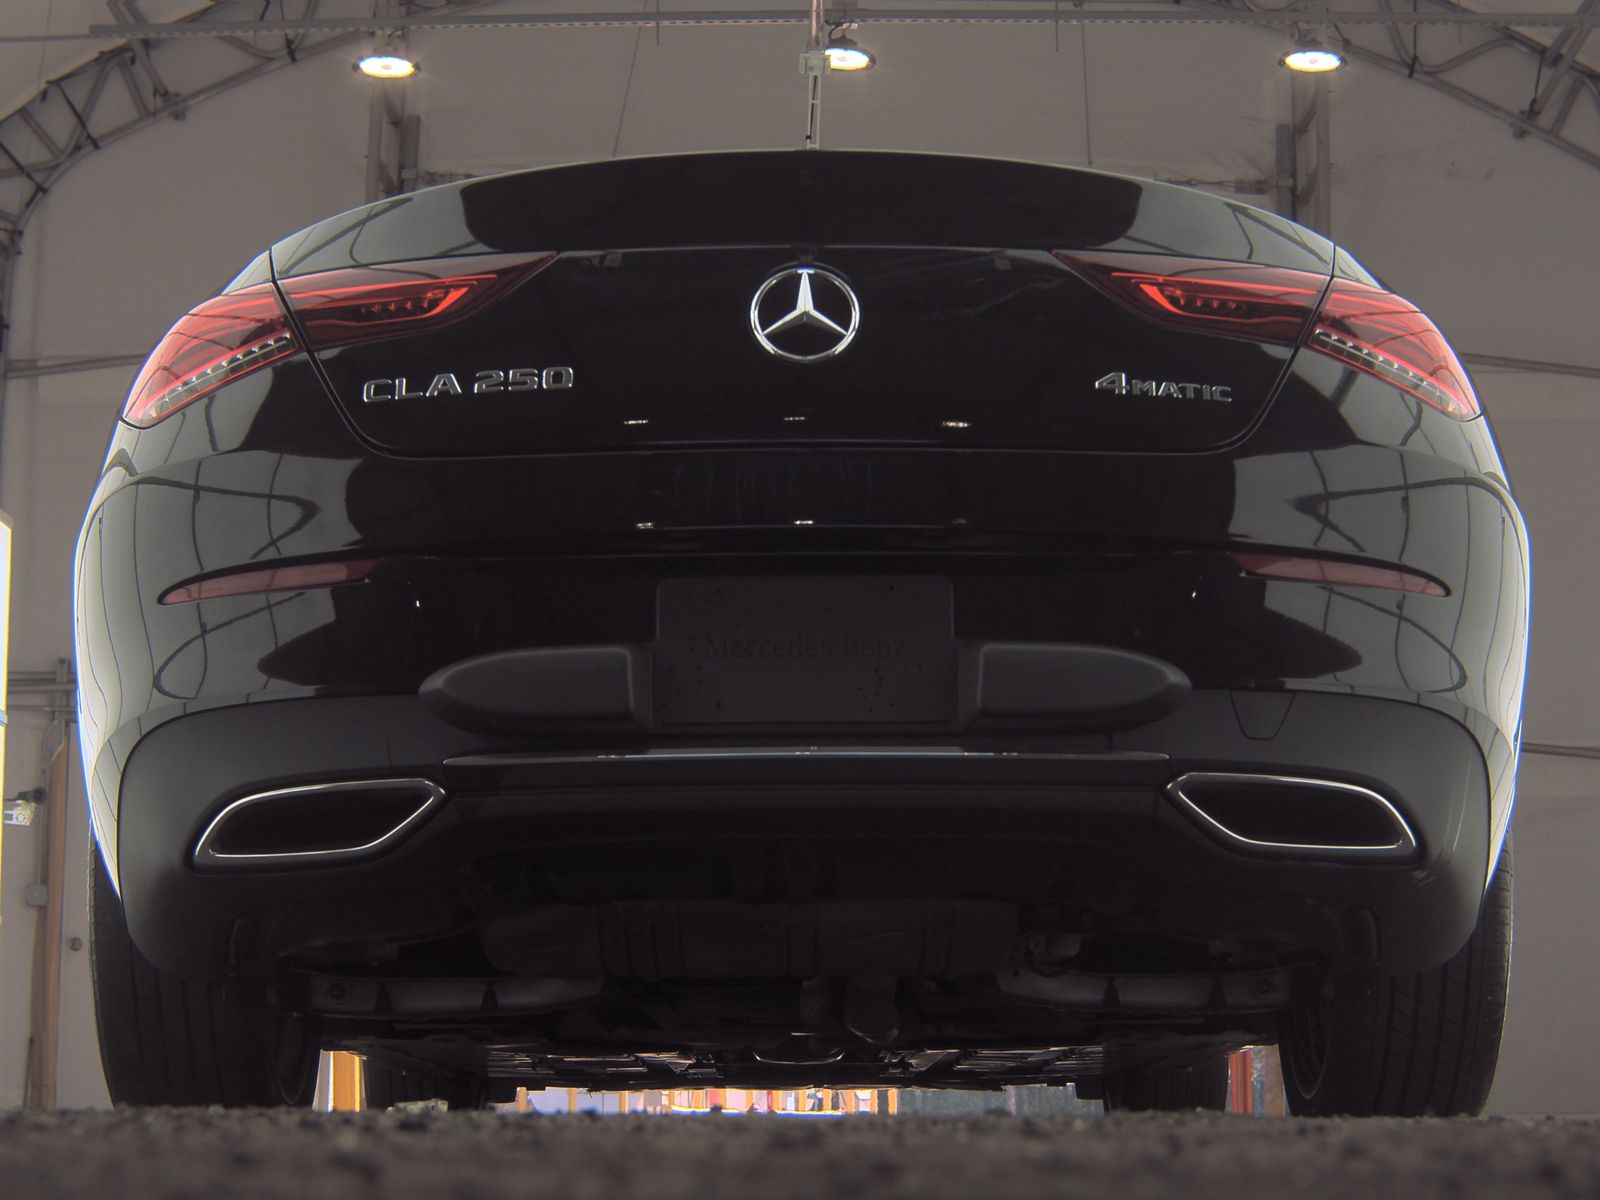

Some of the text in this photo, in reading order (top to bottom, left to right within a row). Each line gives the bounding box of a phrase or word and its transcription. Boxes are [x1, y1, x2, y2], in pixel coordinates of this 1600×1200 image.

[363, 366, 573, 402] CLA 250
[1094, 372, 1233, 402] 4MATIC
[704, 633, 907, 659] Mercedes-Benz
